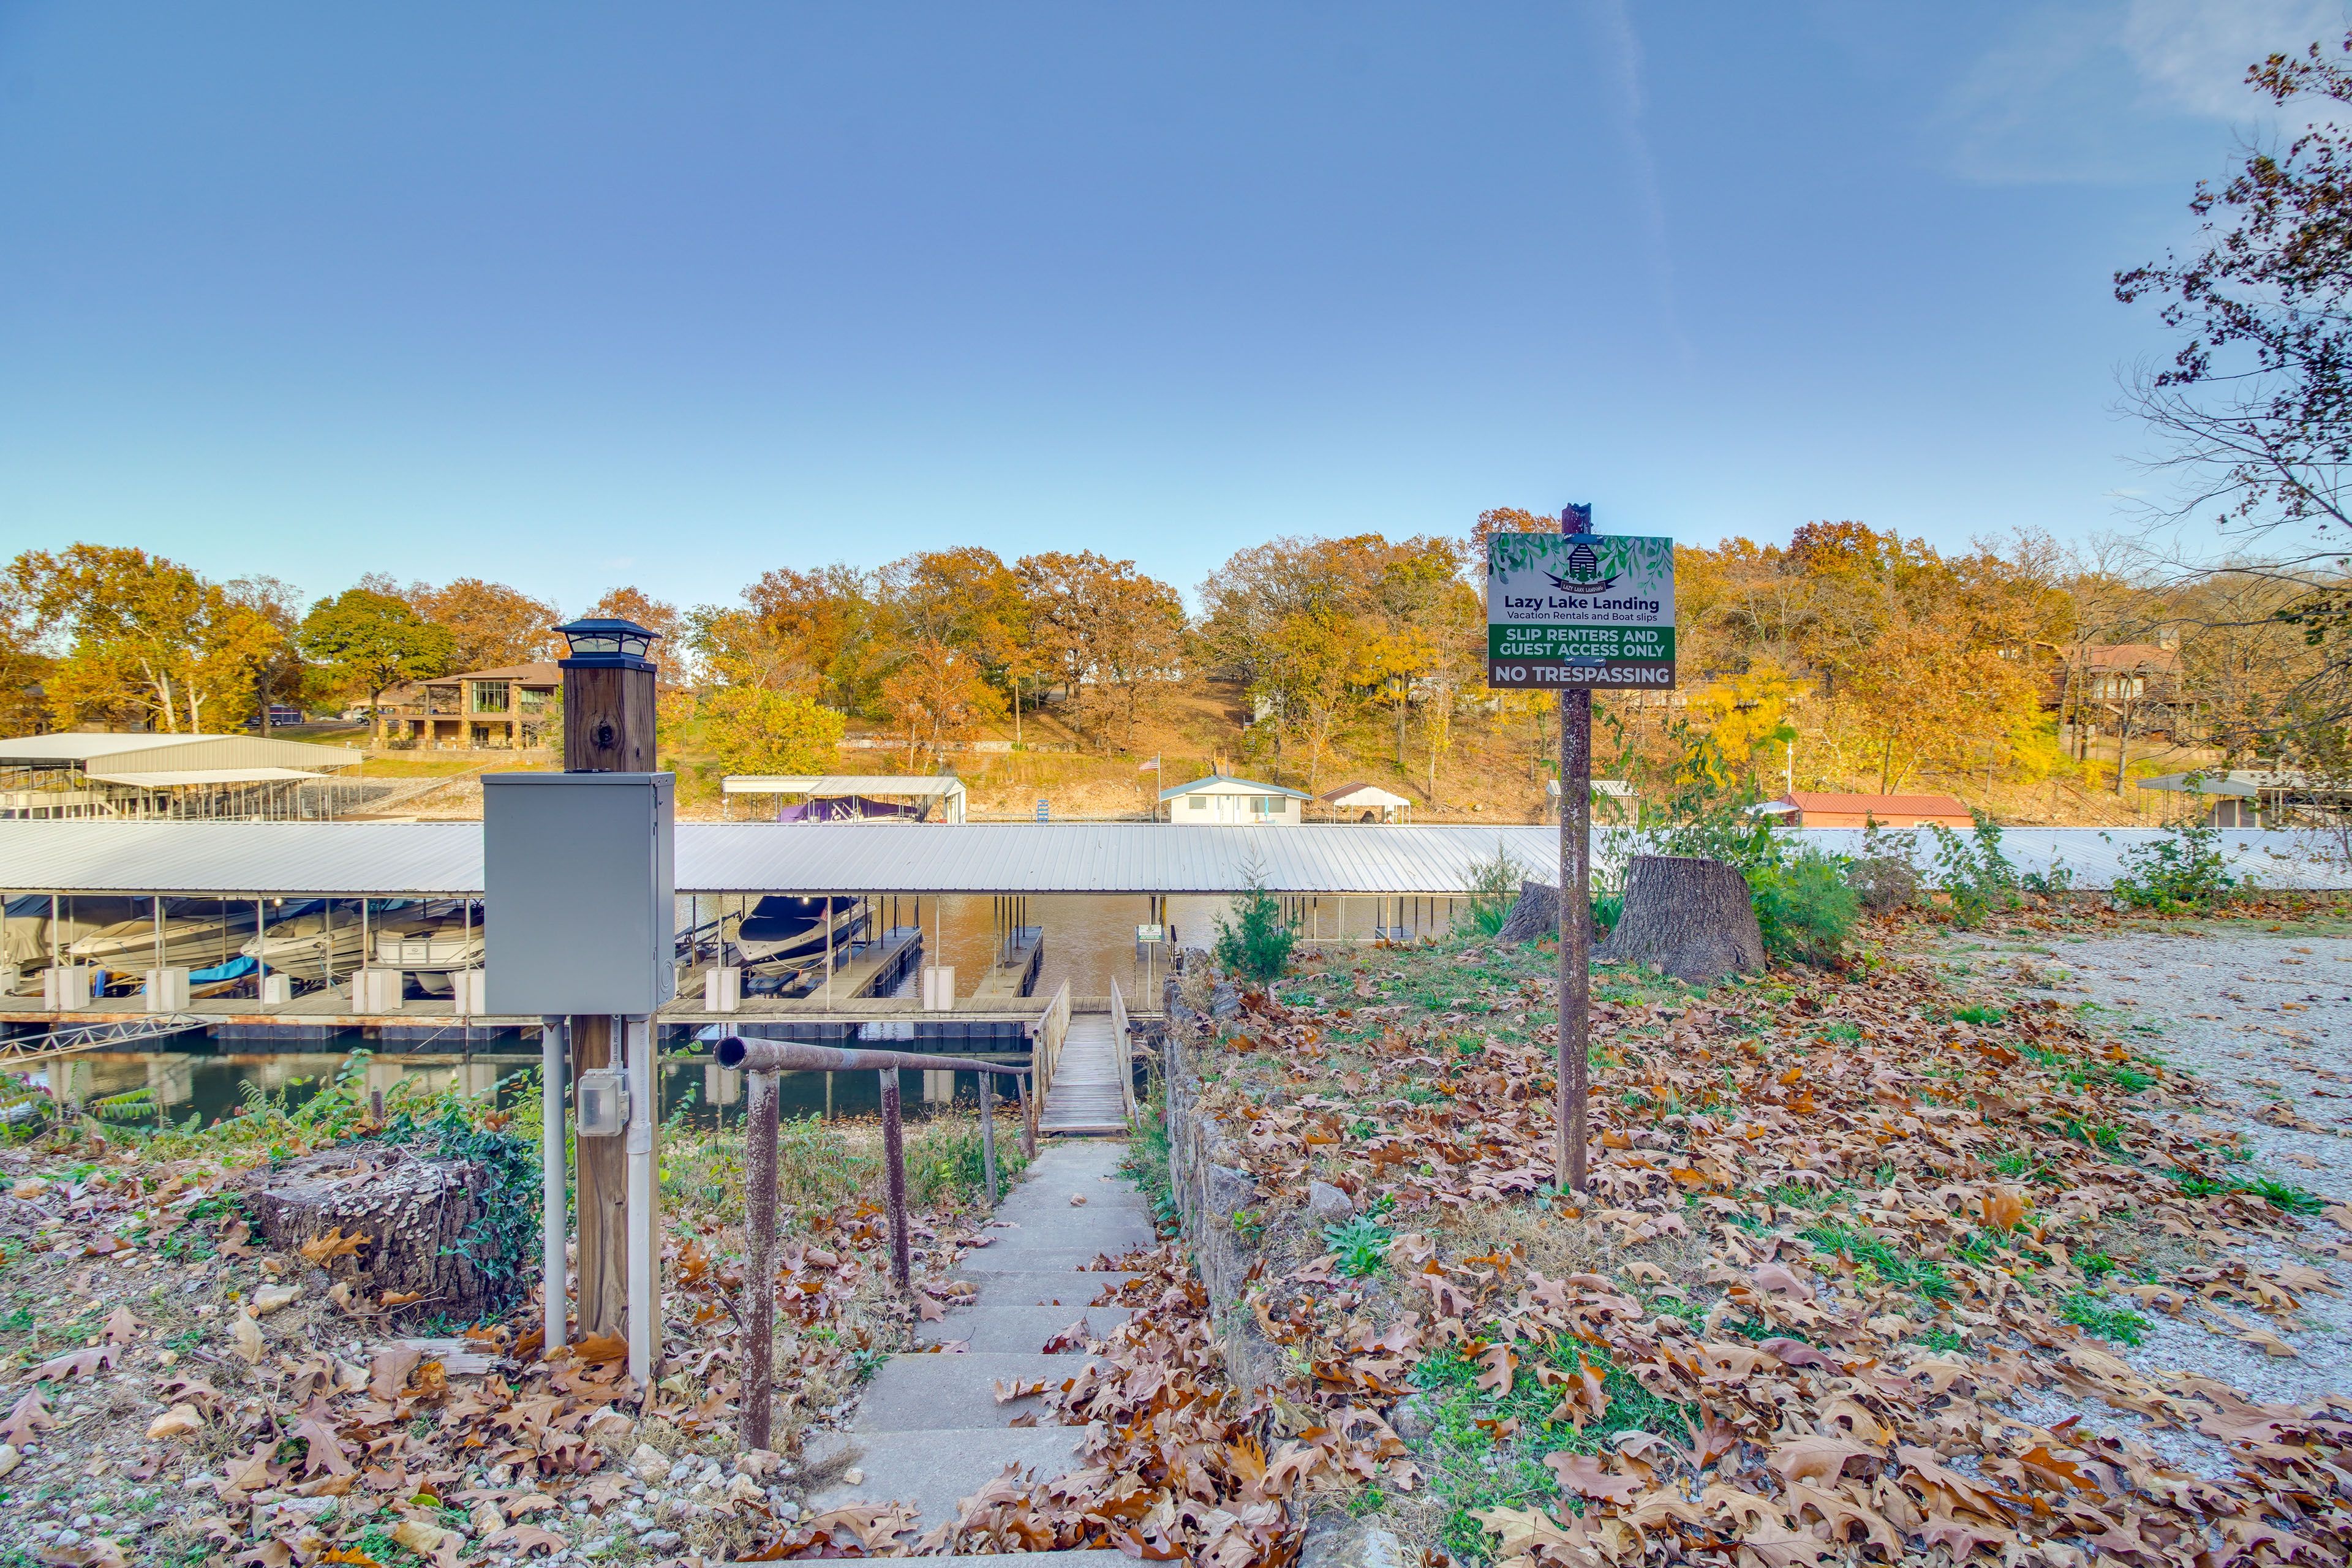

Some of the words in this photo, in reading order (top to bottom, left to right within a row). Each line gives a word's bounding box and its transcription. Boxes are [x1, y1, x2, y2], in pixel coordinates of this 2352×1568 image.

[1505, 595, 1544, 611] Lazy
[1548, 595, 1588, 609] Lake
[1593, 597, 1659, 613] Landing
[1553, 611, 1589, 620] Rentals
[1636, 613, 1657, 622] slips
[1506, 628, 1542, 641] SLIP
[1547, 629, 1619, 643] RENTERS
[1623, 630, 1659, 643] AND
[1499, 643, 1553, 655] GUEST
[1557, 643, 1619, 657] ACCESS
[1623, 644, 1665, 657] ONLY
[1495, 666, 1527, 682] NO
[1532, 666, 1670, 684] TRESPASSING
